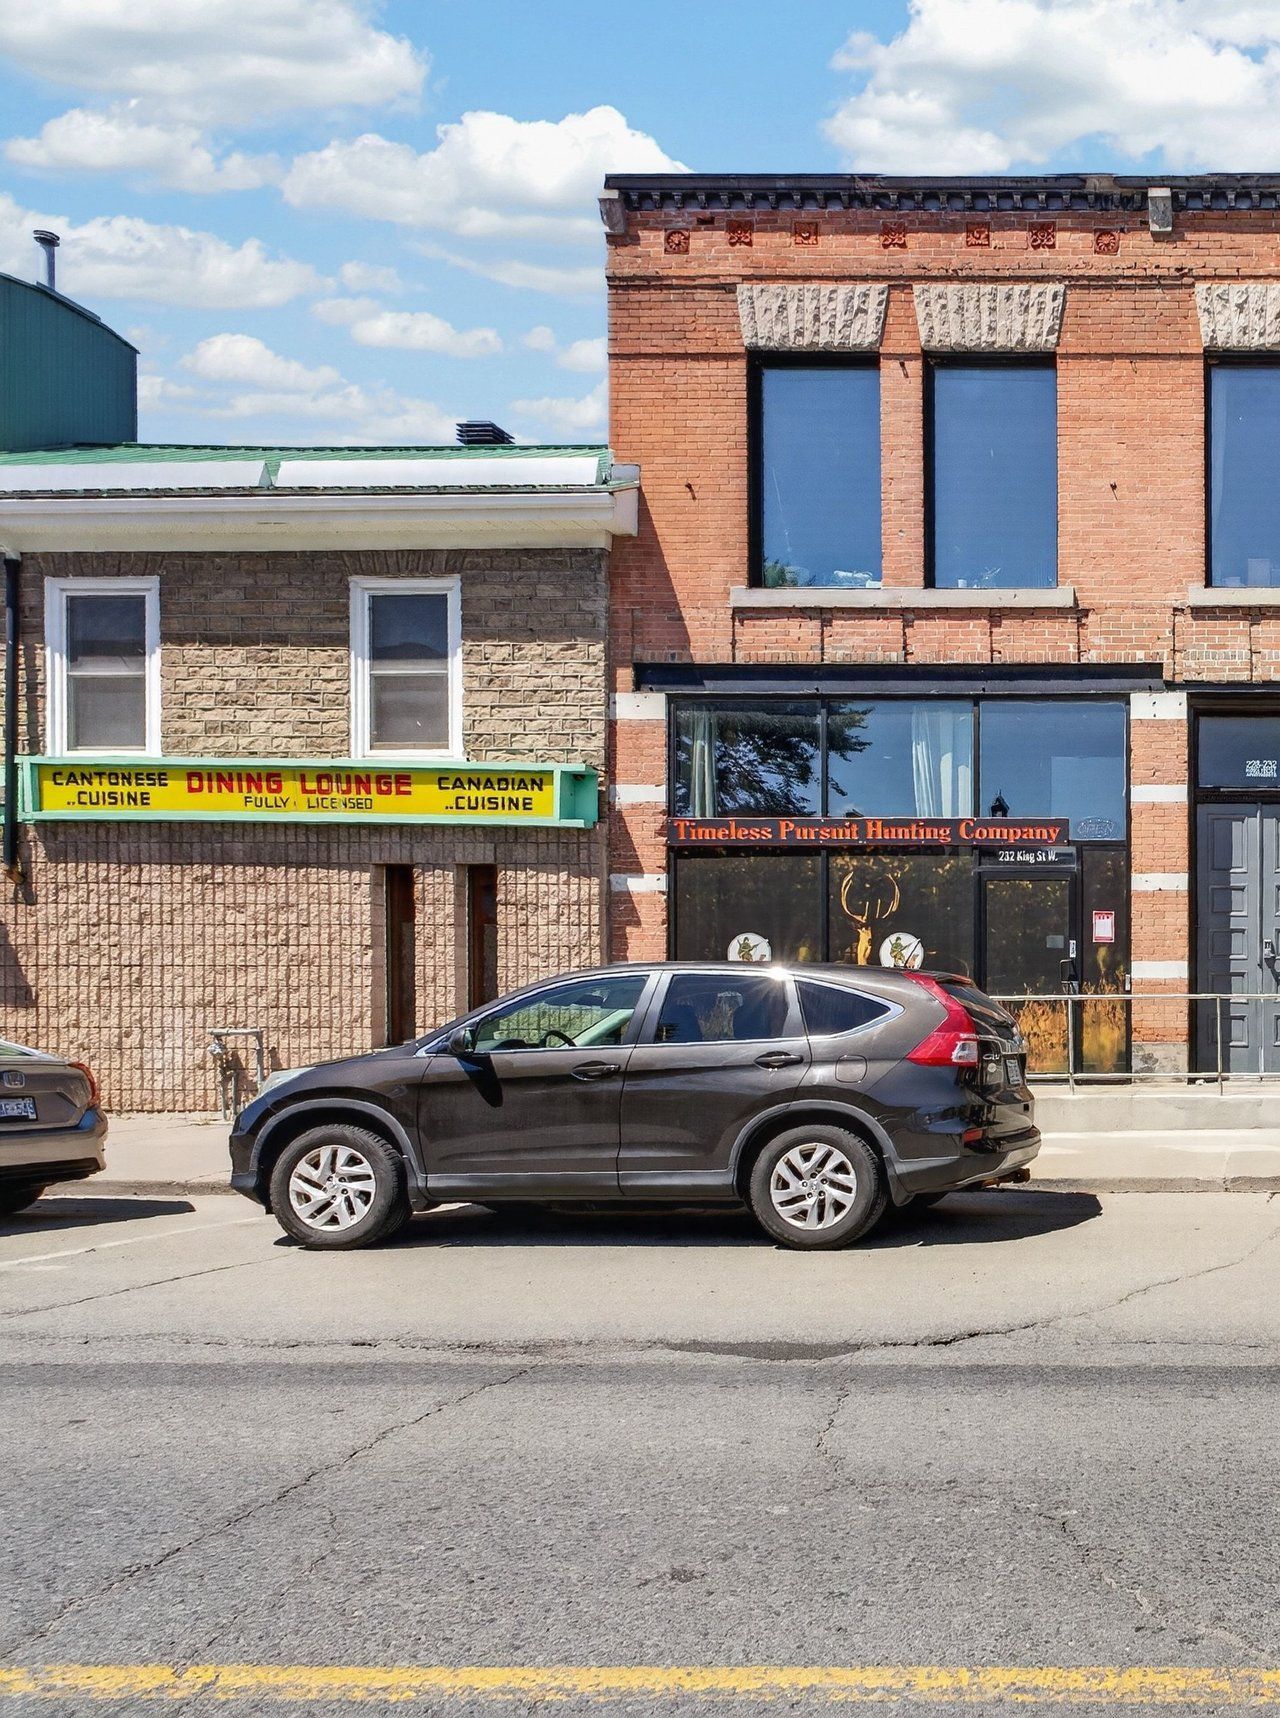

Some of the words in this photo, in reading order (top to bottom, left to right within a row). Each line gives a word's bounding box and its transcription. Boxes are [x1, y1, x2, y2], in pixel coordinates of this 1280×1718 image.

[52, 771, 168, 787] CANTONESE
[186, 771, 283, 794] DINING
[300, 772, 412, 796] LOUNGE
[437, 776, 544, 792] CANADIAN
[244, 796, 290, 809] FULLY
[307, 797, 373, 810] LICENSED
[673, 819, 773, 841] Timeless
[779, 819, 860, 841] Pursuit
[865, 819, 952, 843] Hunting
[958, 819, 1062, 843] Company
[998, 850, 1015, 862] 232
[1016, 850, 1035, 864] King
[1036, 850, 1047, 862] St
